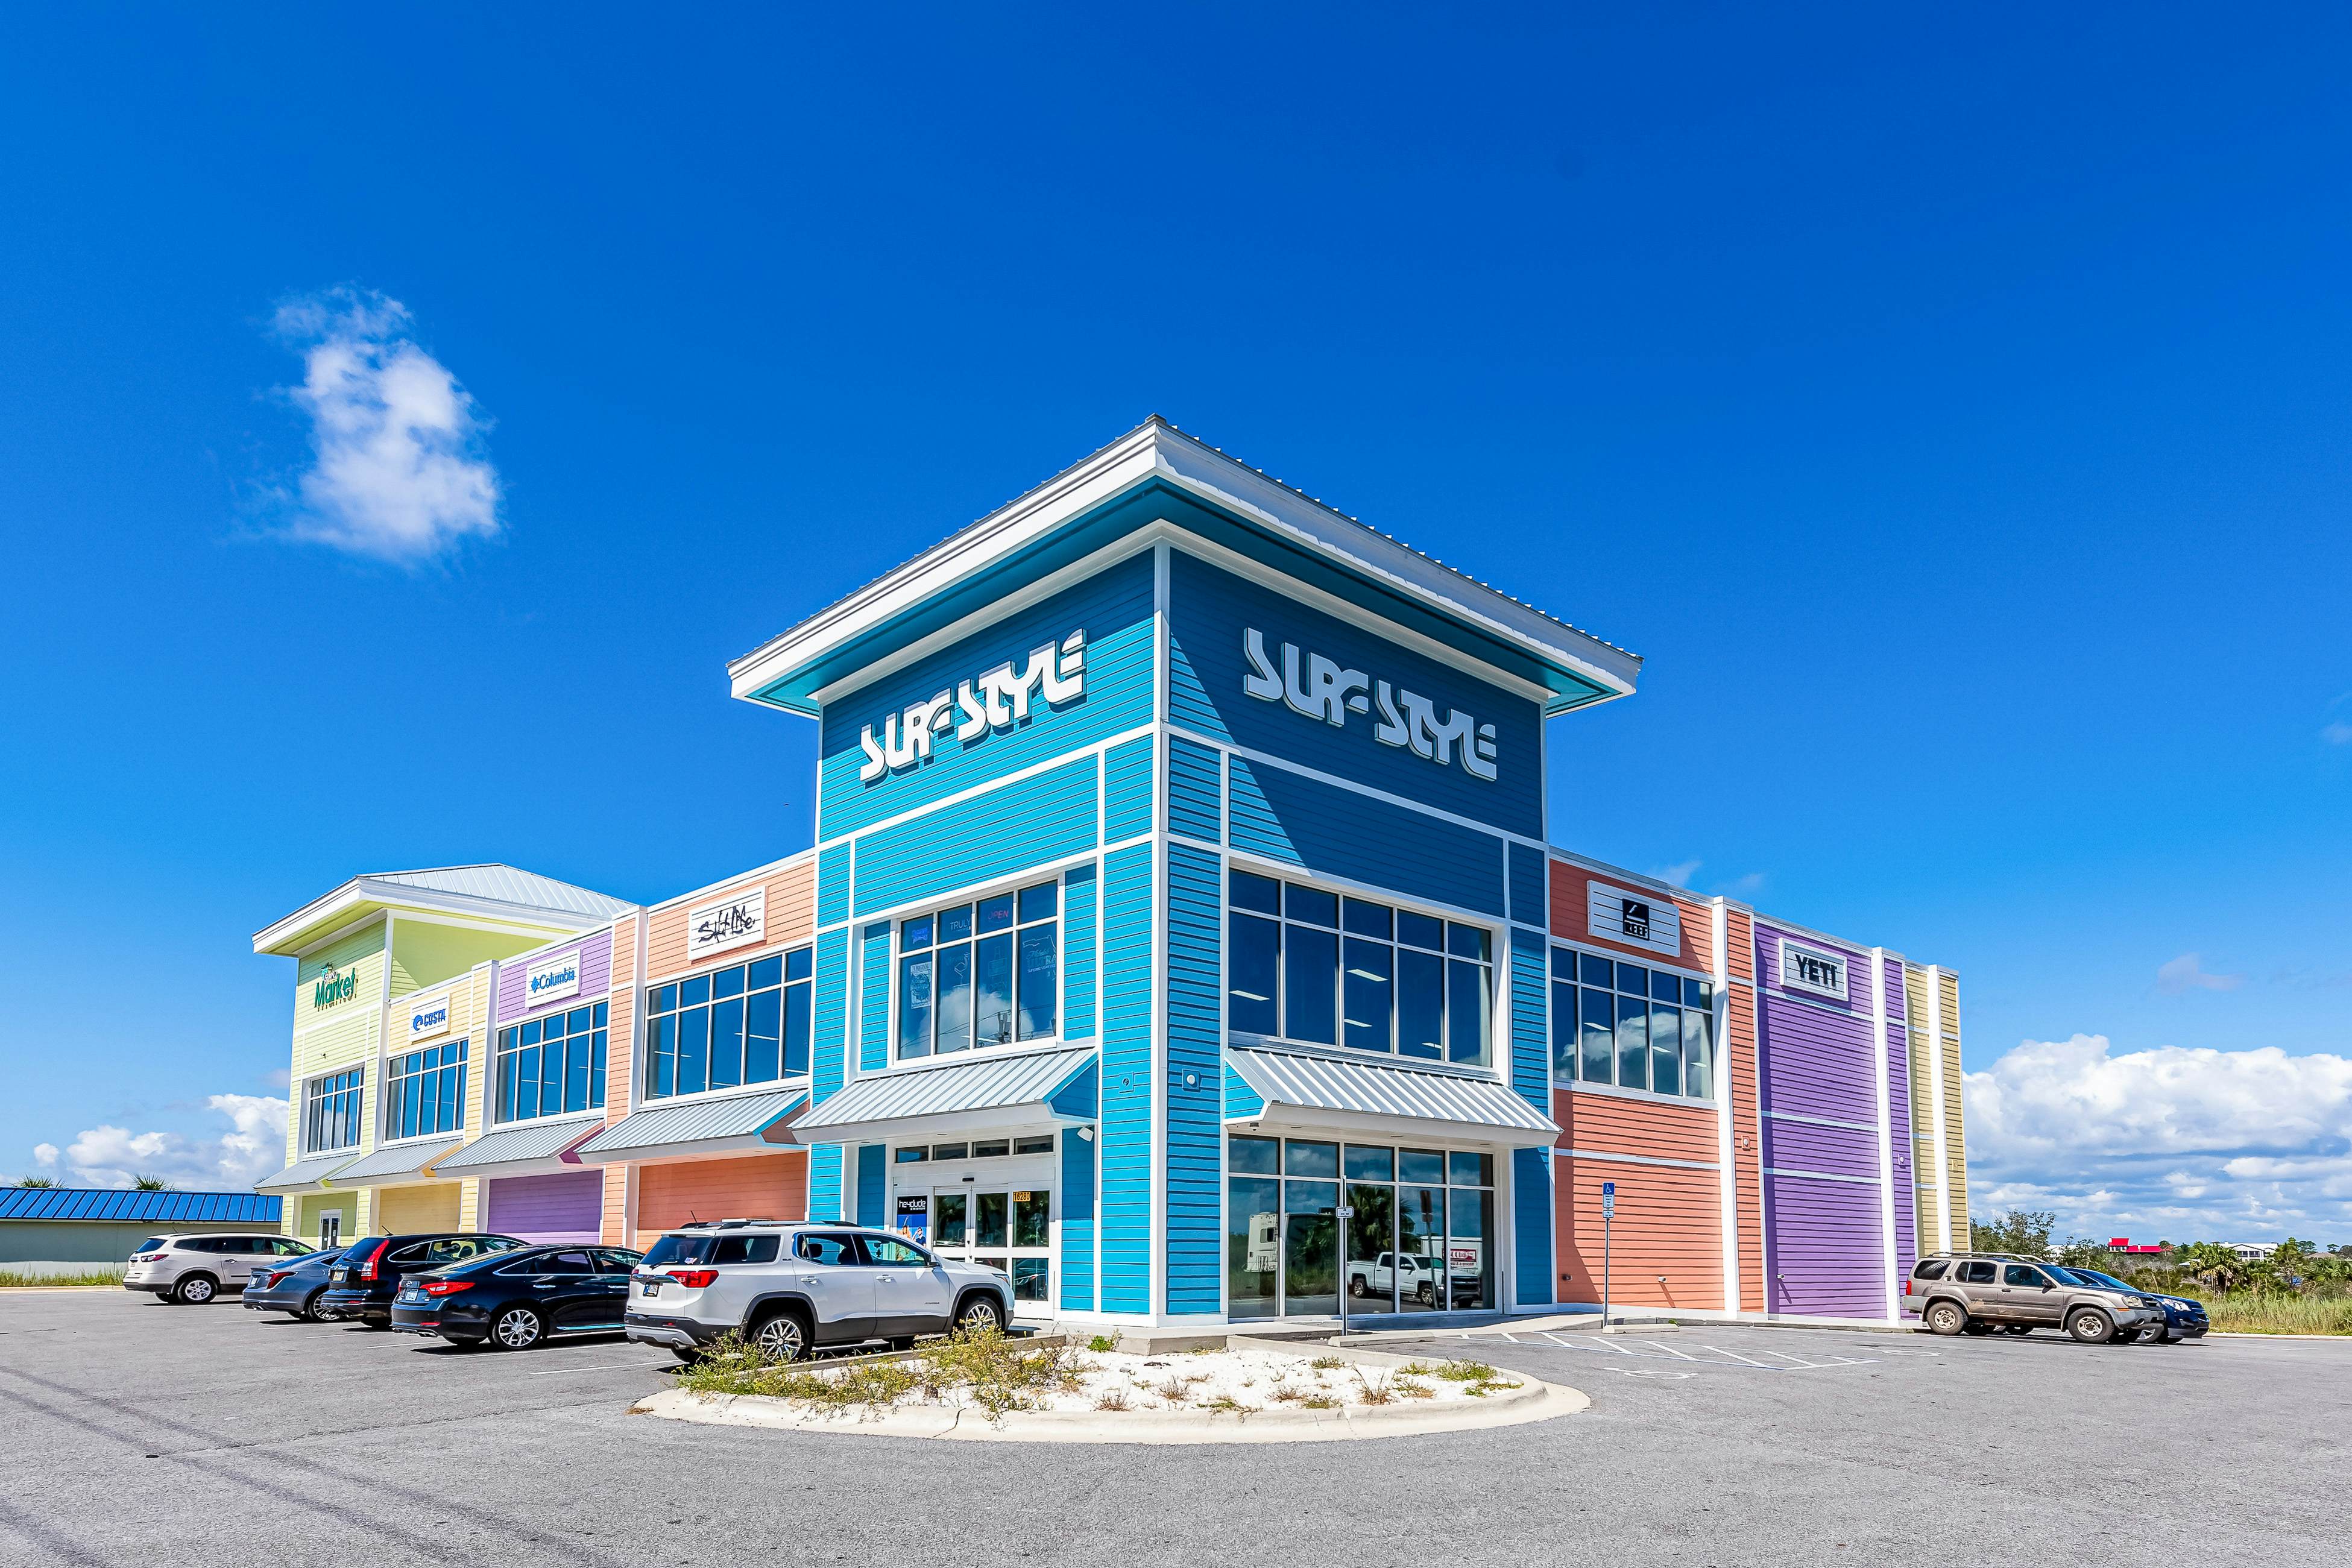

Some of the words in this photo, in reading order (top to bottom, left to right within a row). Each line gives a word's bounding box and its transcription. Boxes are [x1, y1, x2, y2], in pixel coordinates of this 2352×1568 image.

[950, 918, 971, 931] TRULY
[1625, 922, 1648, 937] REEF
[539, 966, 575, 990] Columbia
[1795, 954, 1836, 987] YETI
[314, 968, 356, 1008] Market
[424, 1009, 446, 1027] COSTA
[1014, 1192, 1030, 1201] 16280
